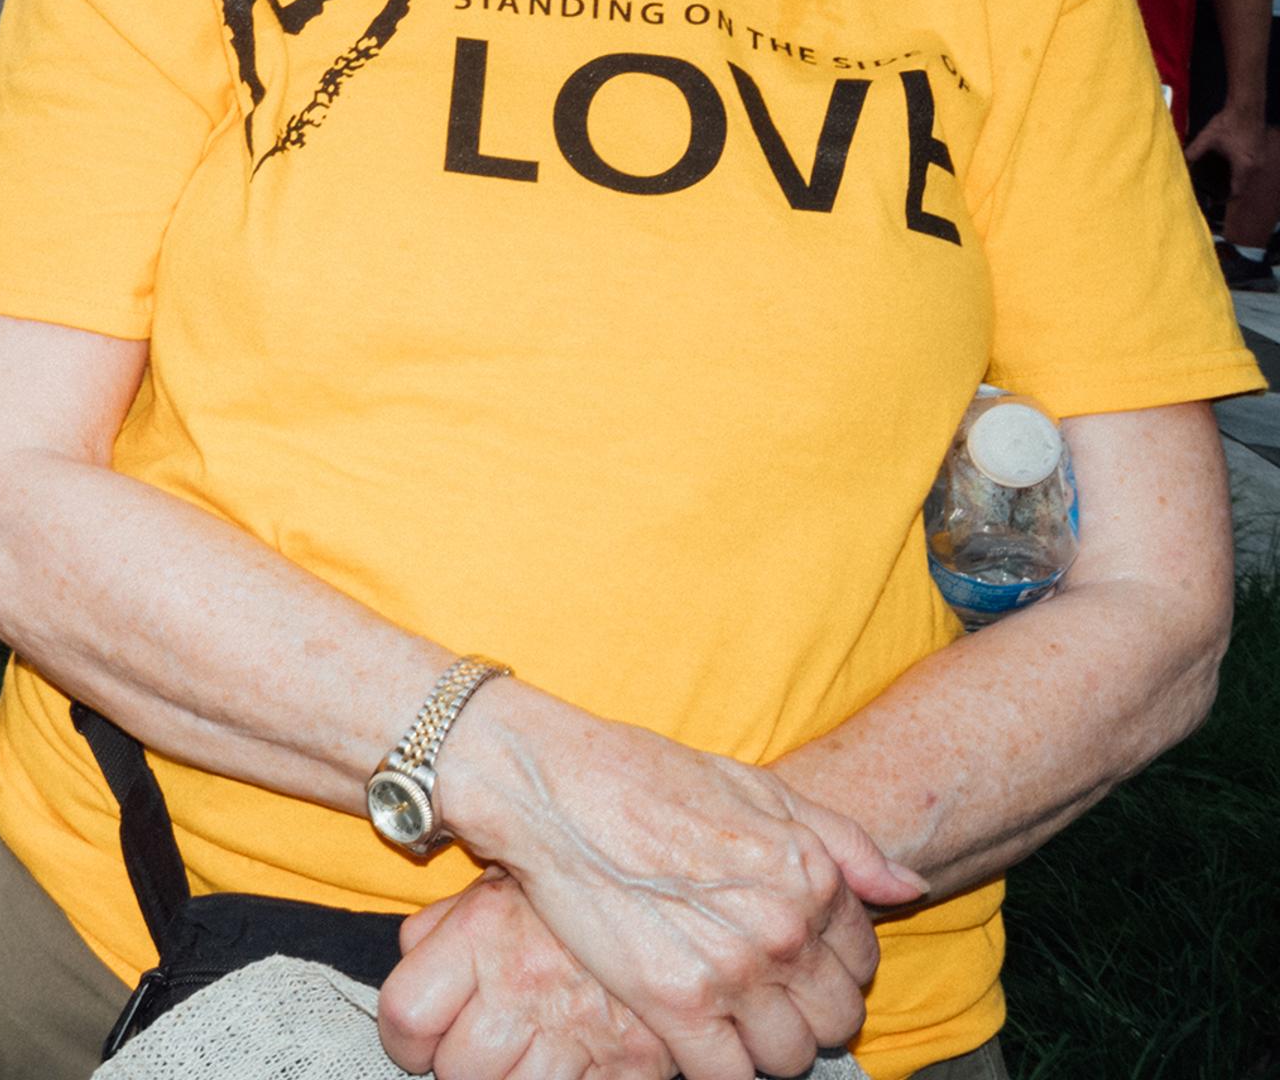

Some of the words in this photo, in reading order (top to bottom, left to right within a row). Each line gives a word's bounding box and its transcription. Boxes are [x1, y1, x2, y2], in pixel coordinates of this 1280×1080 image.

[684, 3, 733, 37] ON
[746, 26, 817, 66] THE
[444, 38, 962, 247] LOVE
